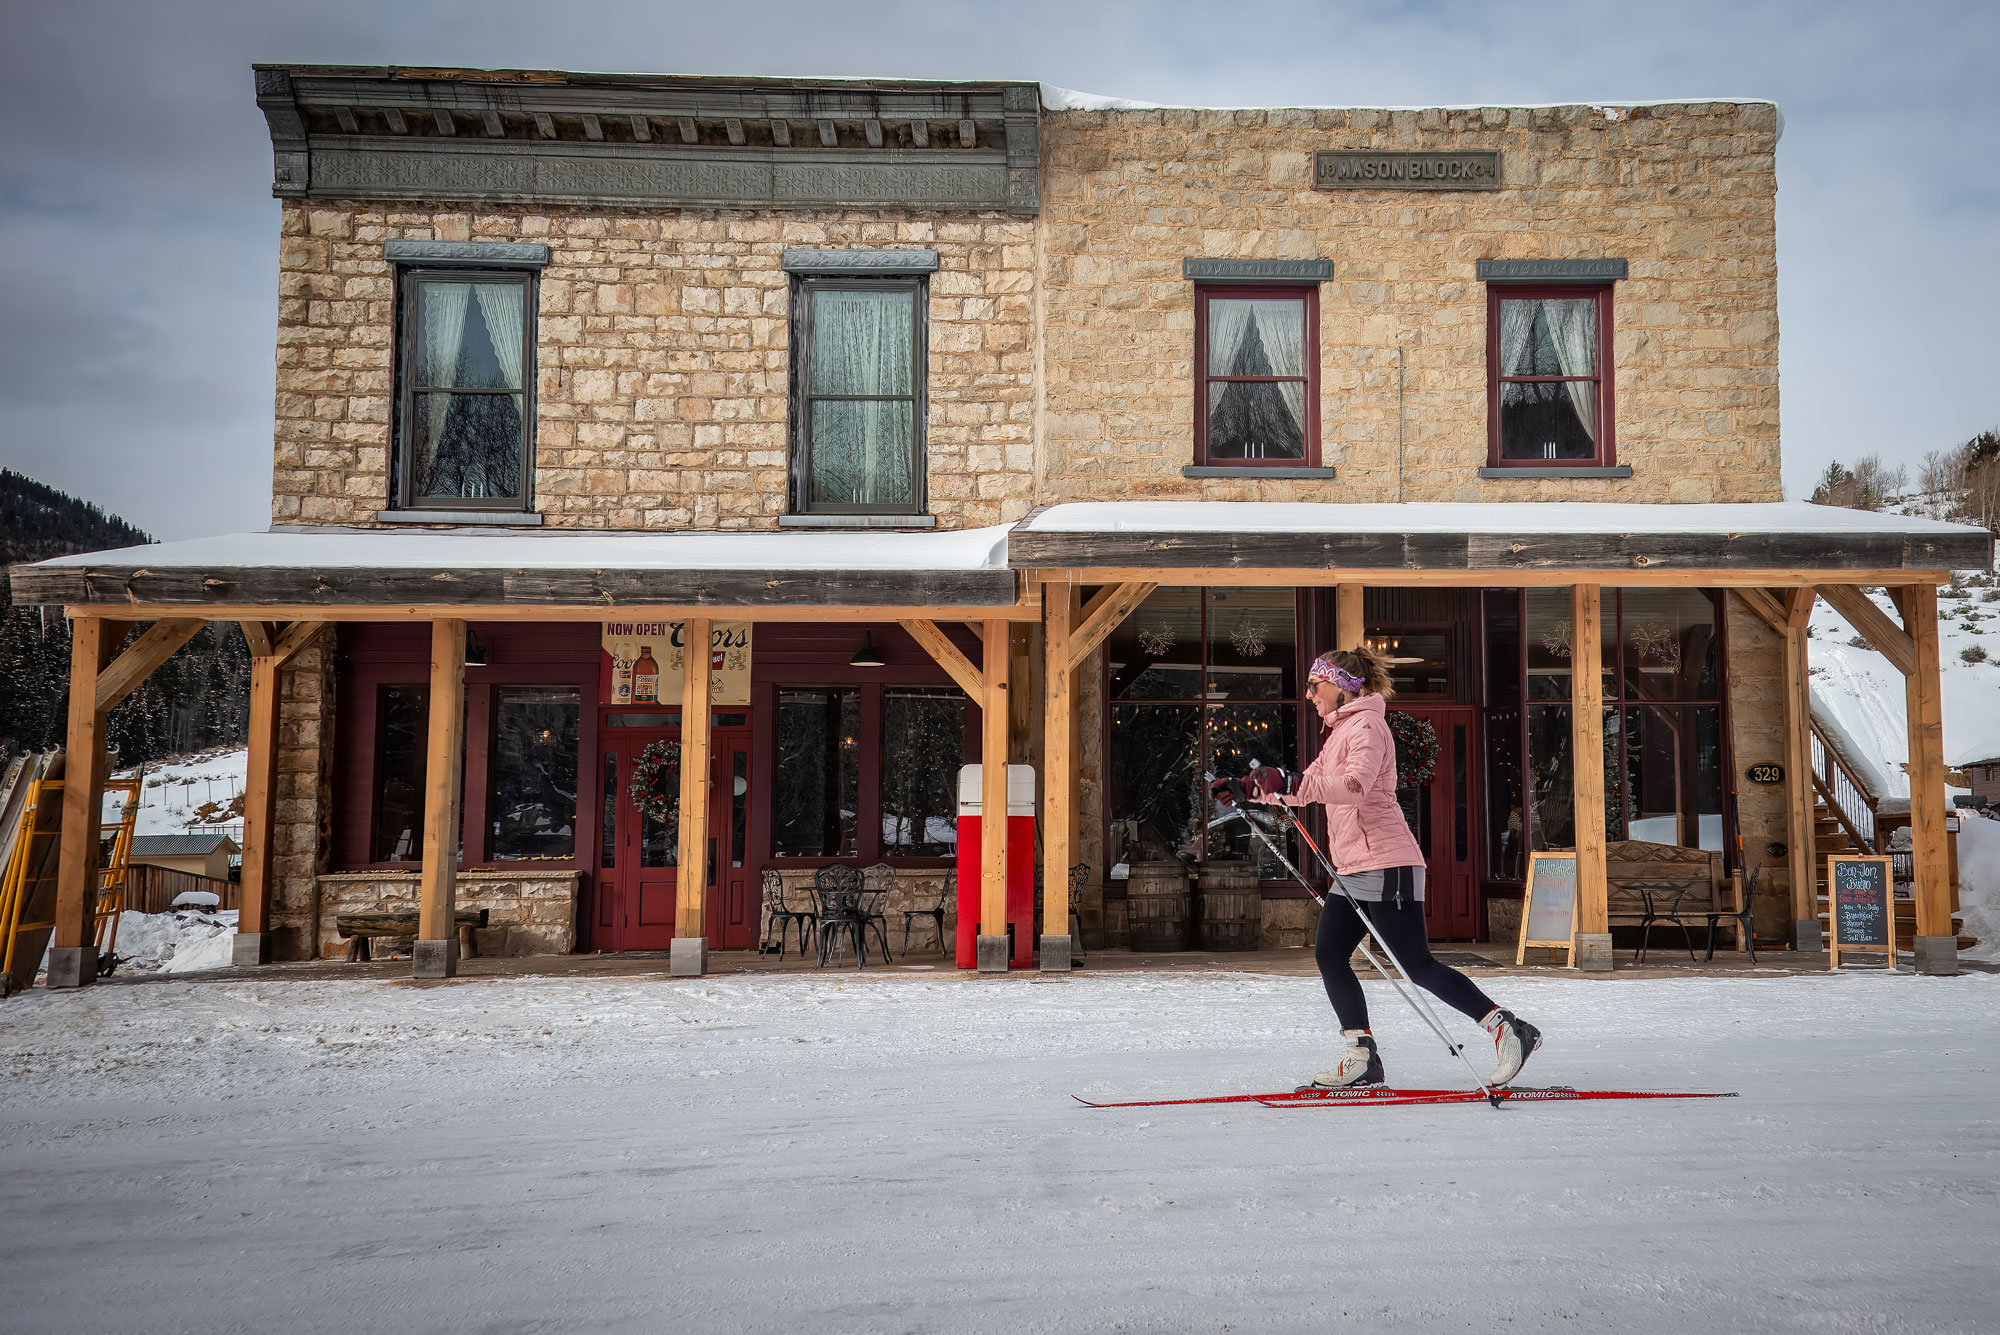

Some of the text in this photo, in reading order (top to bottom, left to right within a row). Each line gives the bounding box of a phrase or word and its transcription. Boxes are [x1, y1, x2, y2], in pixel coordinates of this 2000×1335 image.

[1337, 160, 1404, 179] MASON
[1408, 160, 1474, 179] BLOCK
[607, 623, 666, 636] NOW OPEN
[669, 622, 749, 649] Cors
[1753, 767, 1779, 781] 329
[1326, 1090, 1371, 1098] ATOMIC
[1508, 1091, 1555, 1099] ATOMIC
